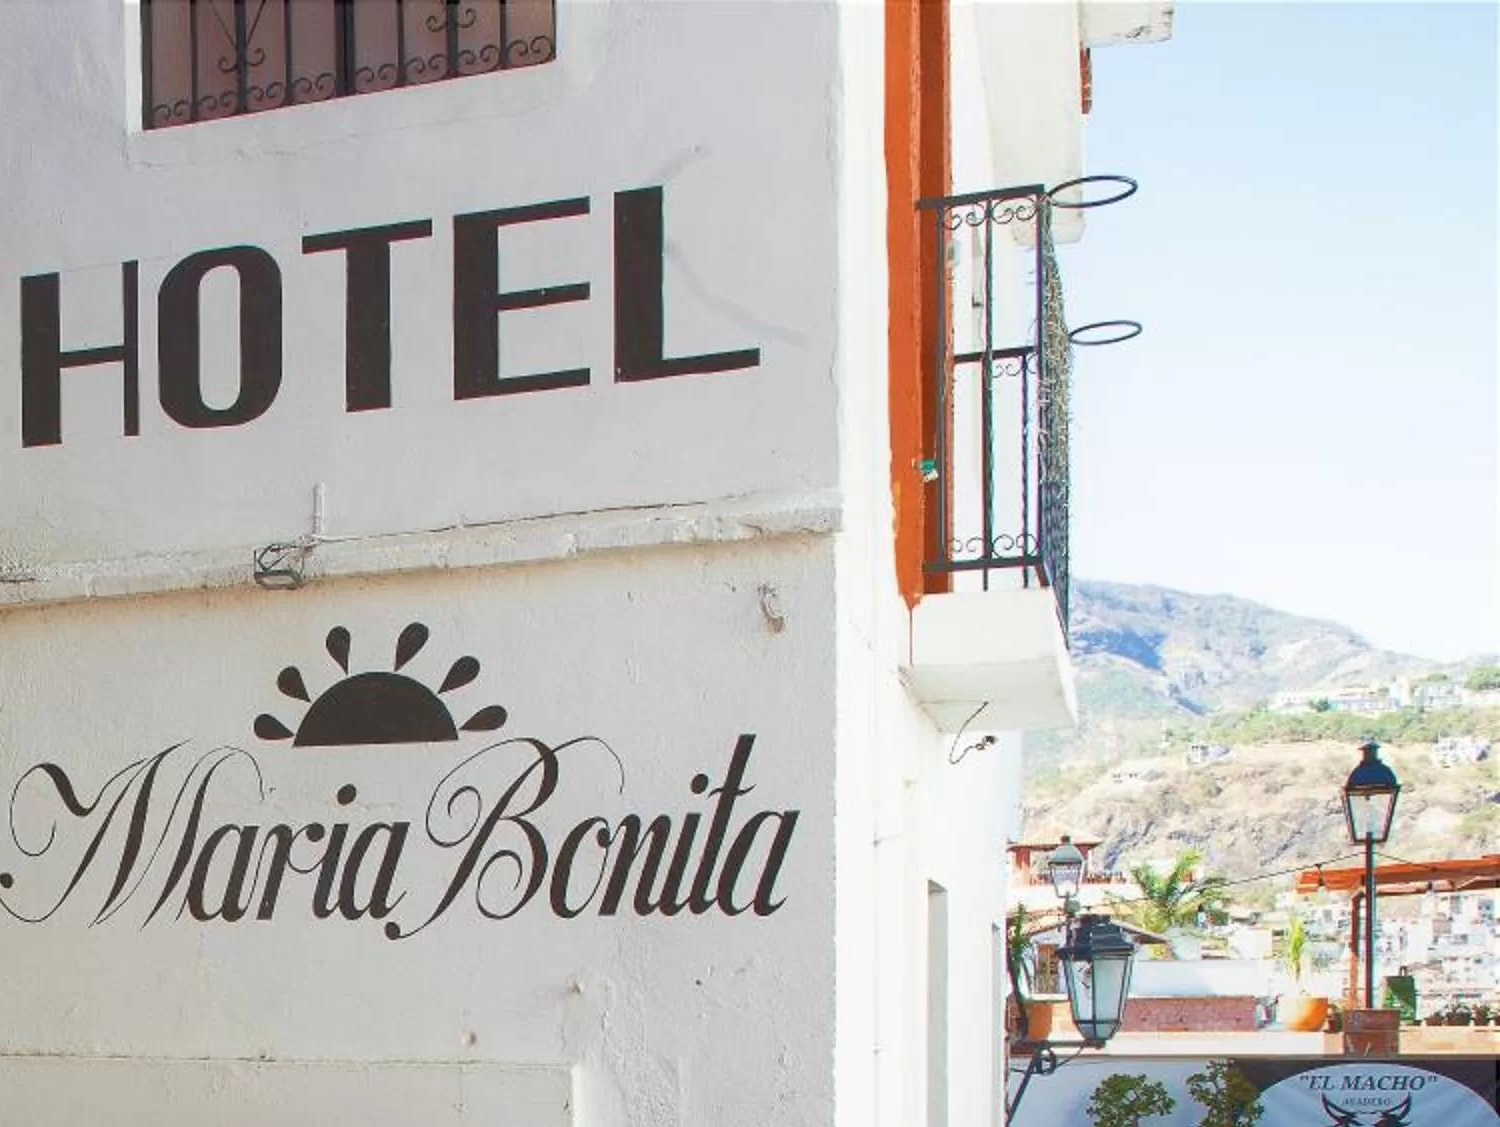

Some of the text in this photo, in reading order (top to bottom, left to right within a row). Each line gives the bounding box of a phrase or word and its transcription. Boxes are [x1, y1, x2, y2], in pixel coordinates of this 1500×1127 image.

[20, 185, 761, 448] HOTEL
[383, 732, 801, 940] Bonita
[1339, 1074, 1438, 1091] MACHO"
